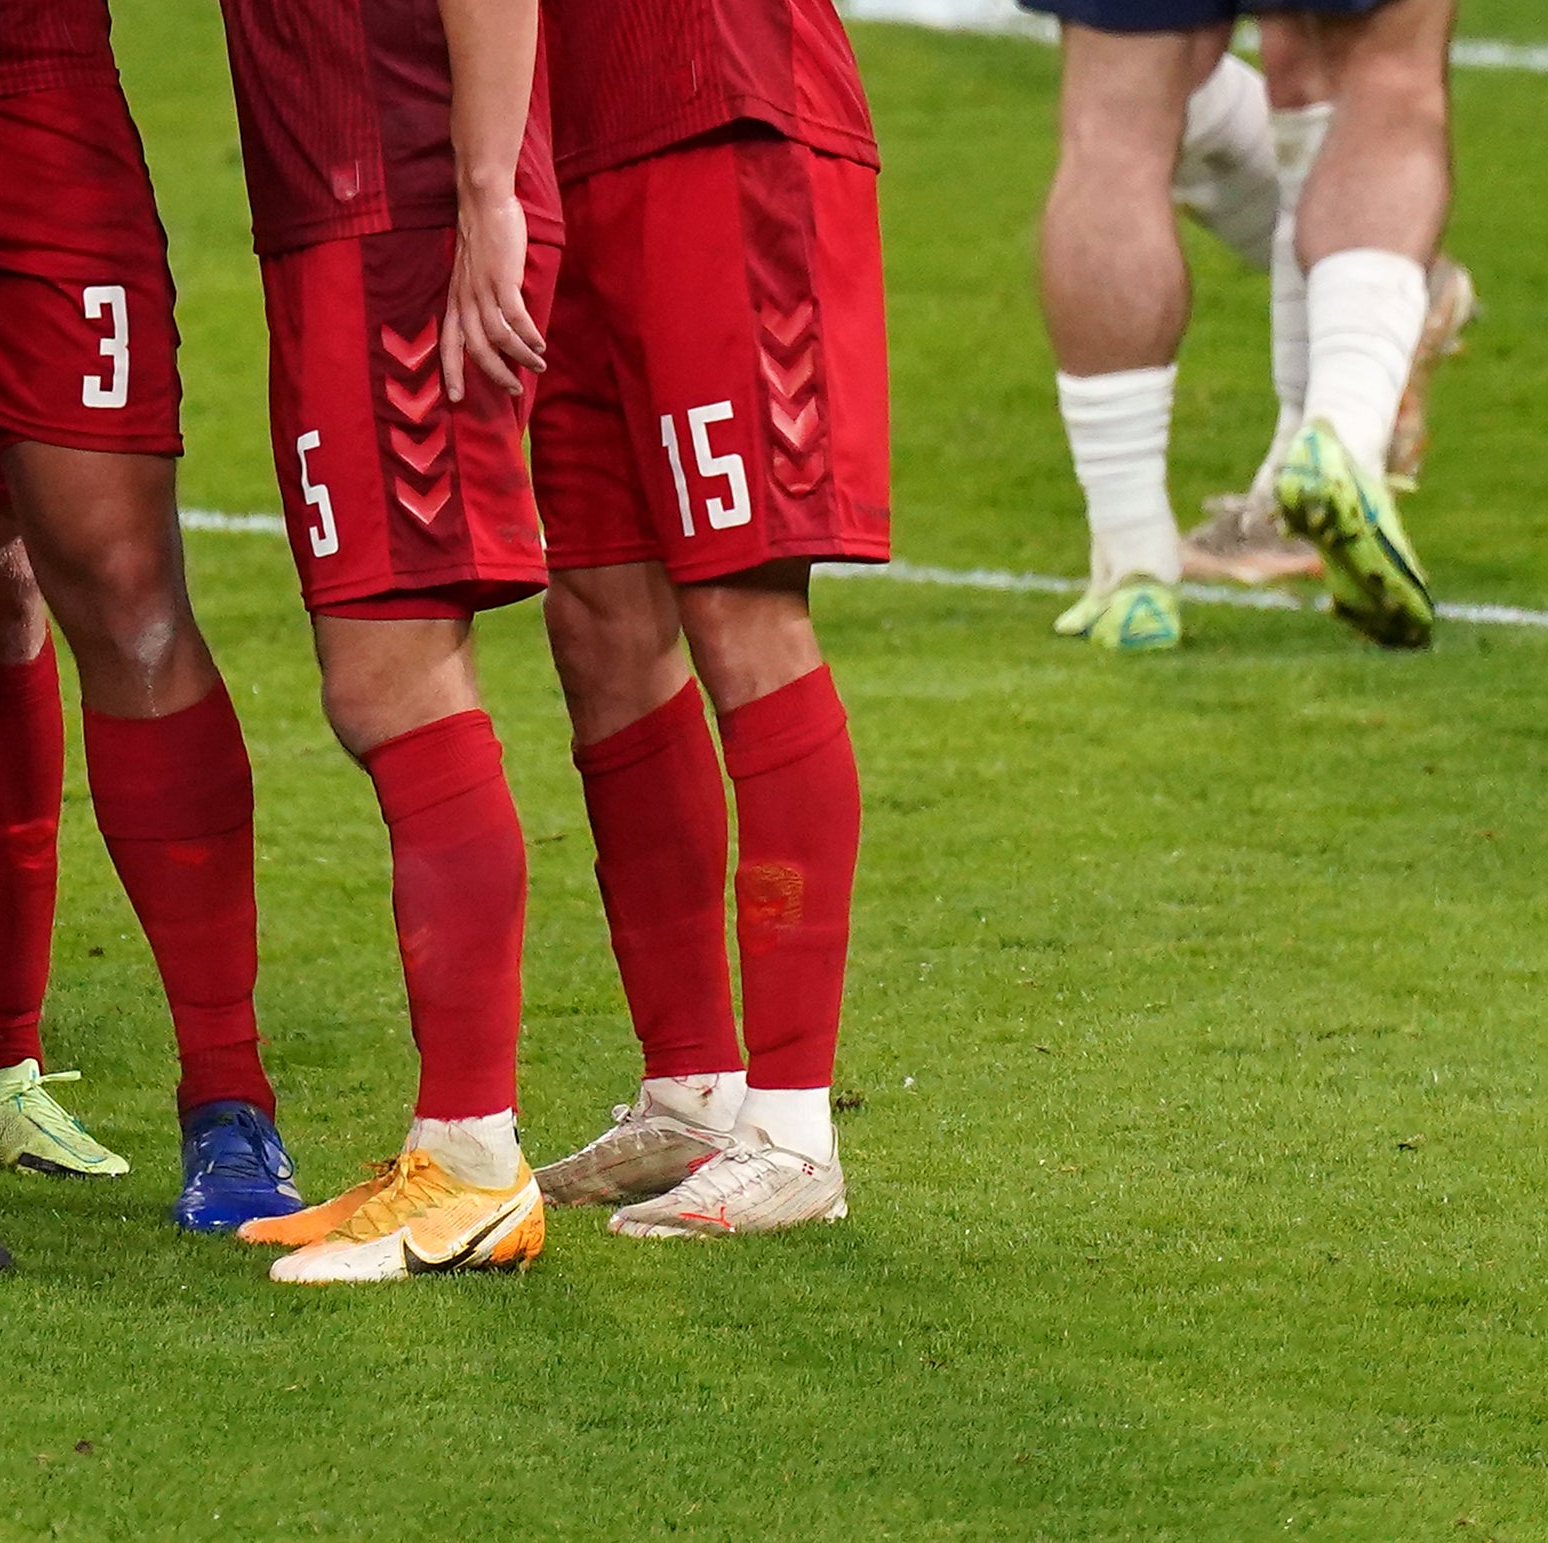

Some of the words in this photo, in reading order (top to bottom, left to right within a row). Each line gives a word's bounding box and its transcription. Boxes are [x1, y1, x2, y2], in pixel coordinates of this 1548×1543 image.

[82, 284, 130, 409] 3
[296, 429, 339, 558] 5
[660, 400, 752, 537] 15
